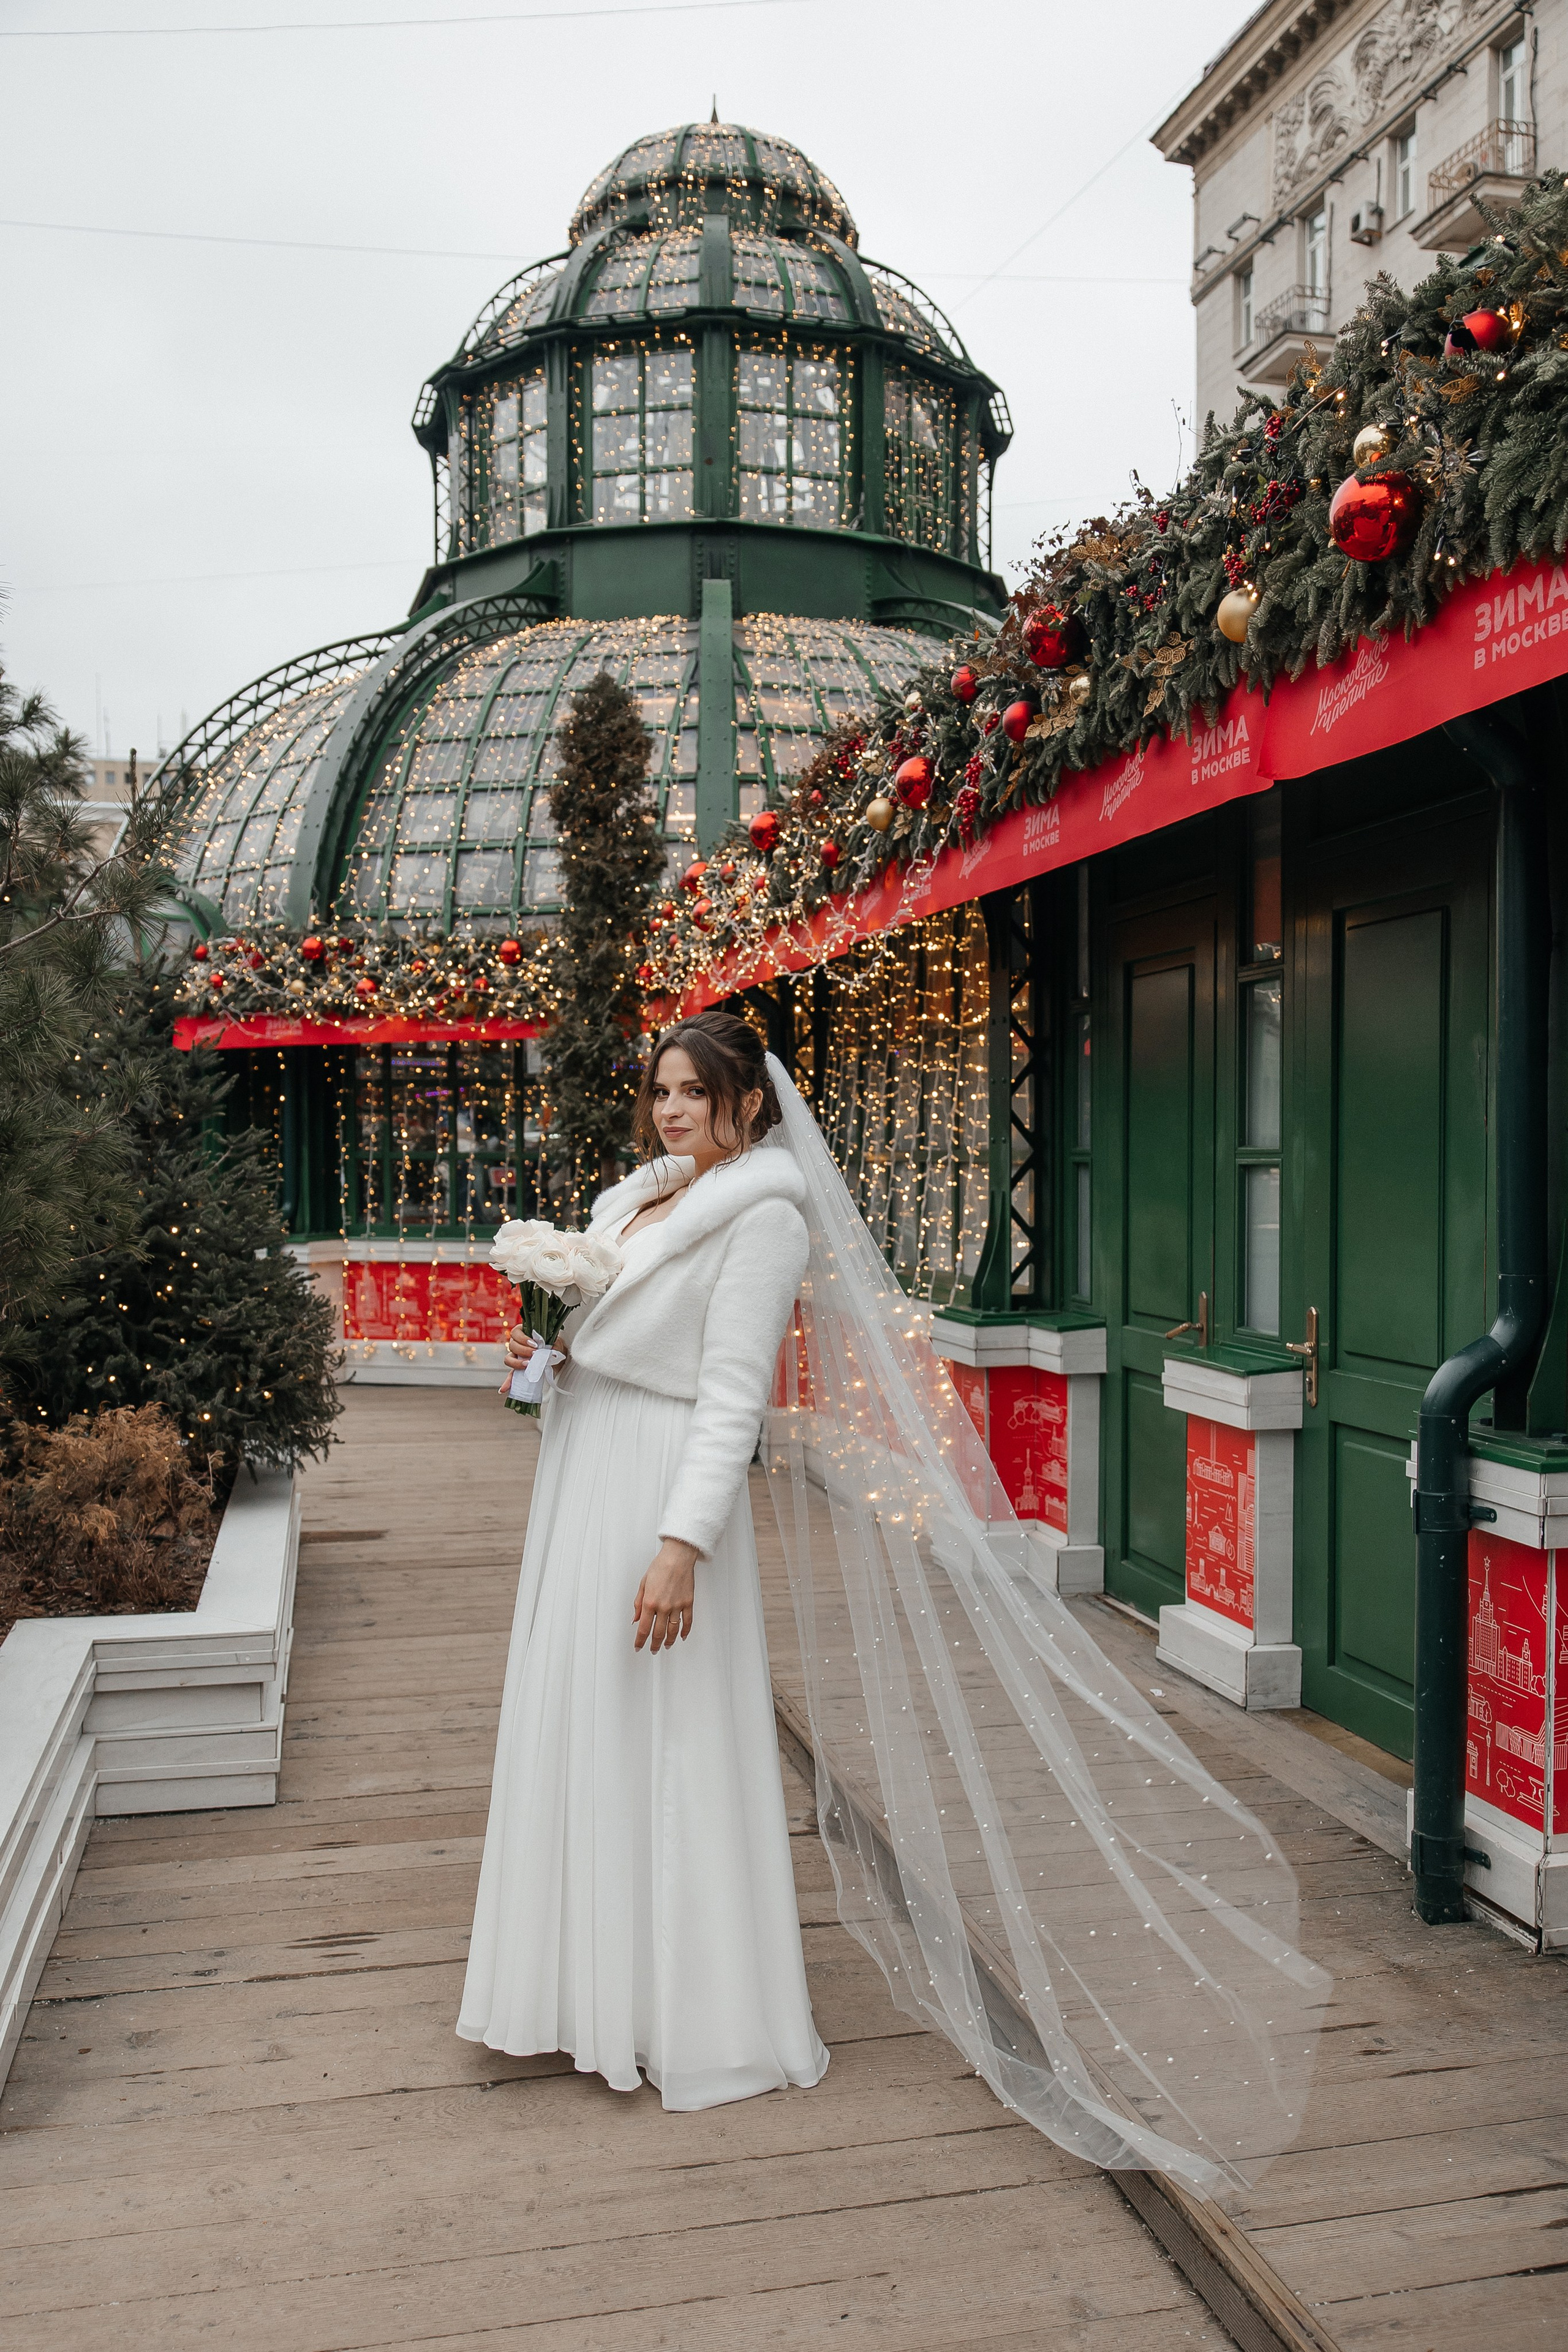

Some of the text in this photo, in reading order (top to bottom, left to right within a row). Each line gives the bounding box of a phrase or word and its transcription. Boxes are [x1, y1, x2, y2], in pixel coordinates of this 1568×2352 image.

[1474, 565, 1568, 642] ЗИМА
[1474, 647, 1486, 669] В
[1191, 715, 1250, 764] ЗИМА
[1191, 747, 1251, 785] В МОСКВЕ
[1024, 804, 1060, 840] ЗИМА
[1023, 829, 1060, 856] В МОСКВЕ
